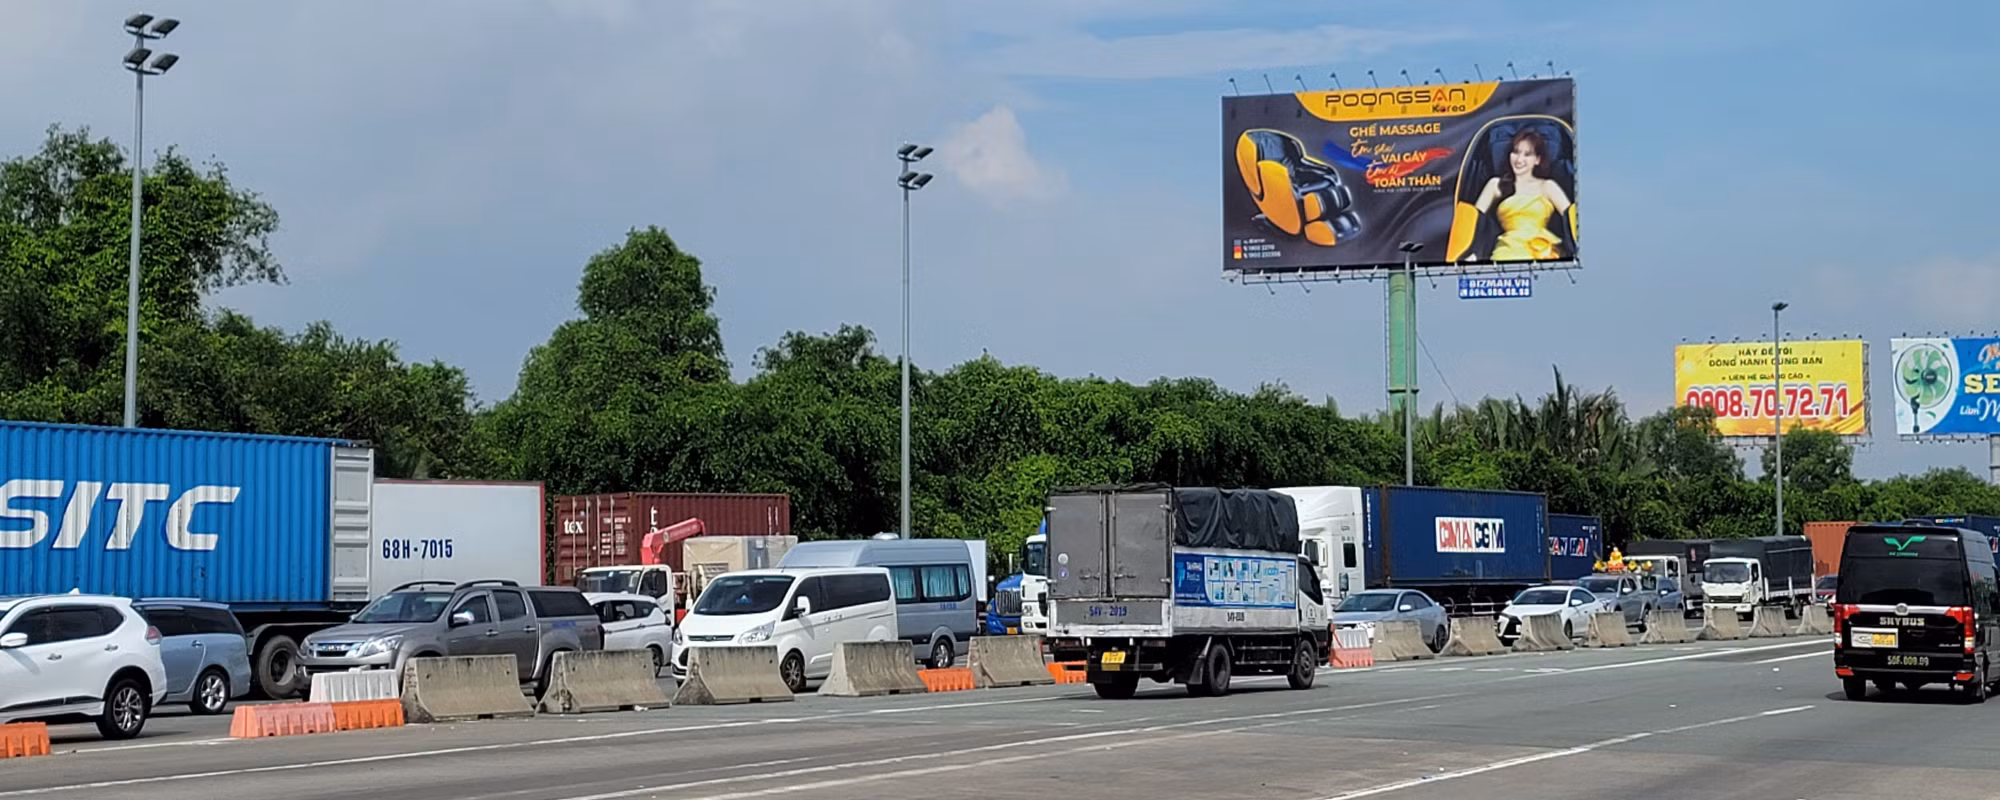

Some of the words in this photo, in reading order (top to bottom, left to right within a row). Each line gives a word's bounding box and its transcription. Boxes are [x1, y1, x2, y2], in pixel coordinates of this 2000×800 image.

[1325, 88, 1466, 108] POONGSAN
[1432, 104, 1466, 113] Korea
[1380, 122, 1441, 136] MASSAGE
[1381, 153, 1401, 163] VAI
[0, 479, 240, 551] SITC
[563, 518, 584, 534] tex
